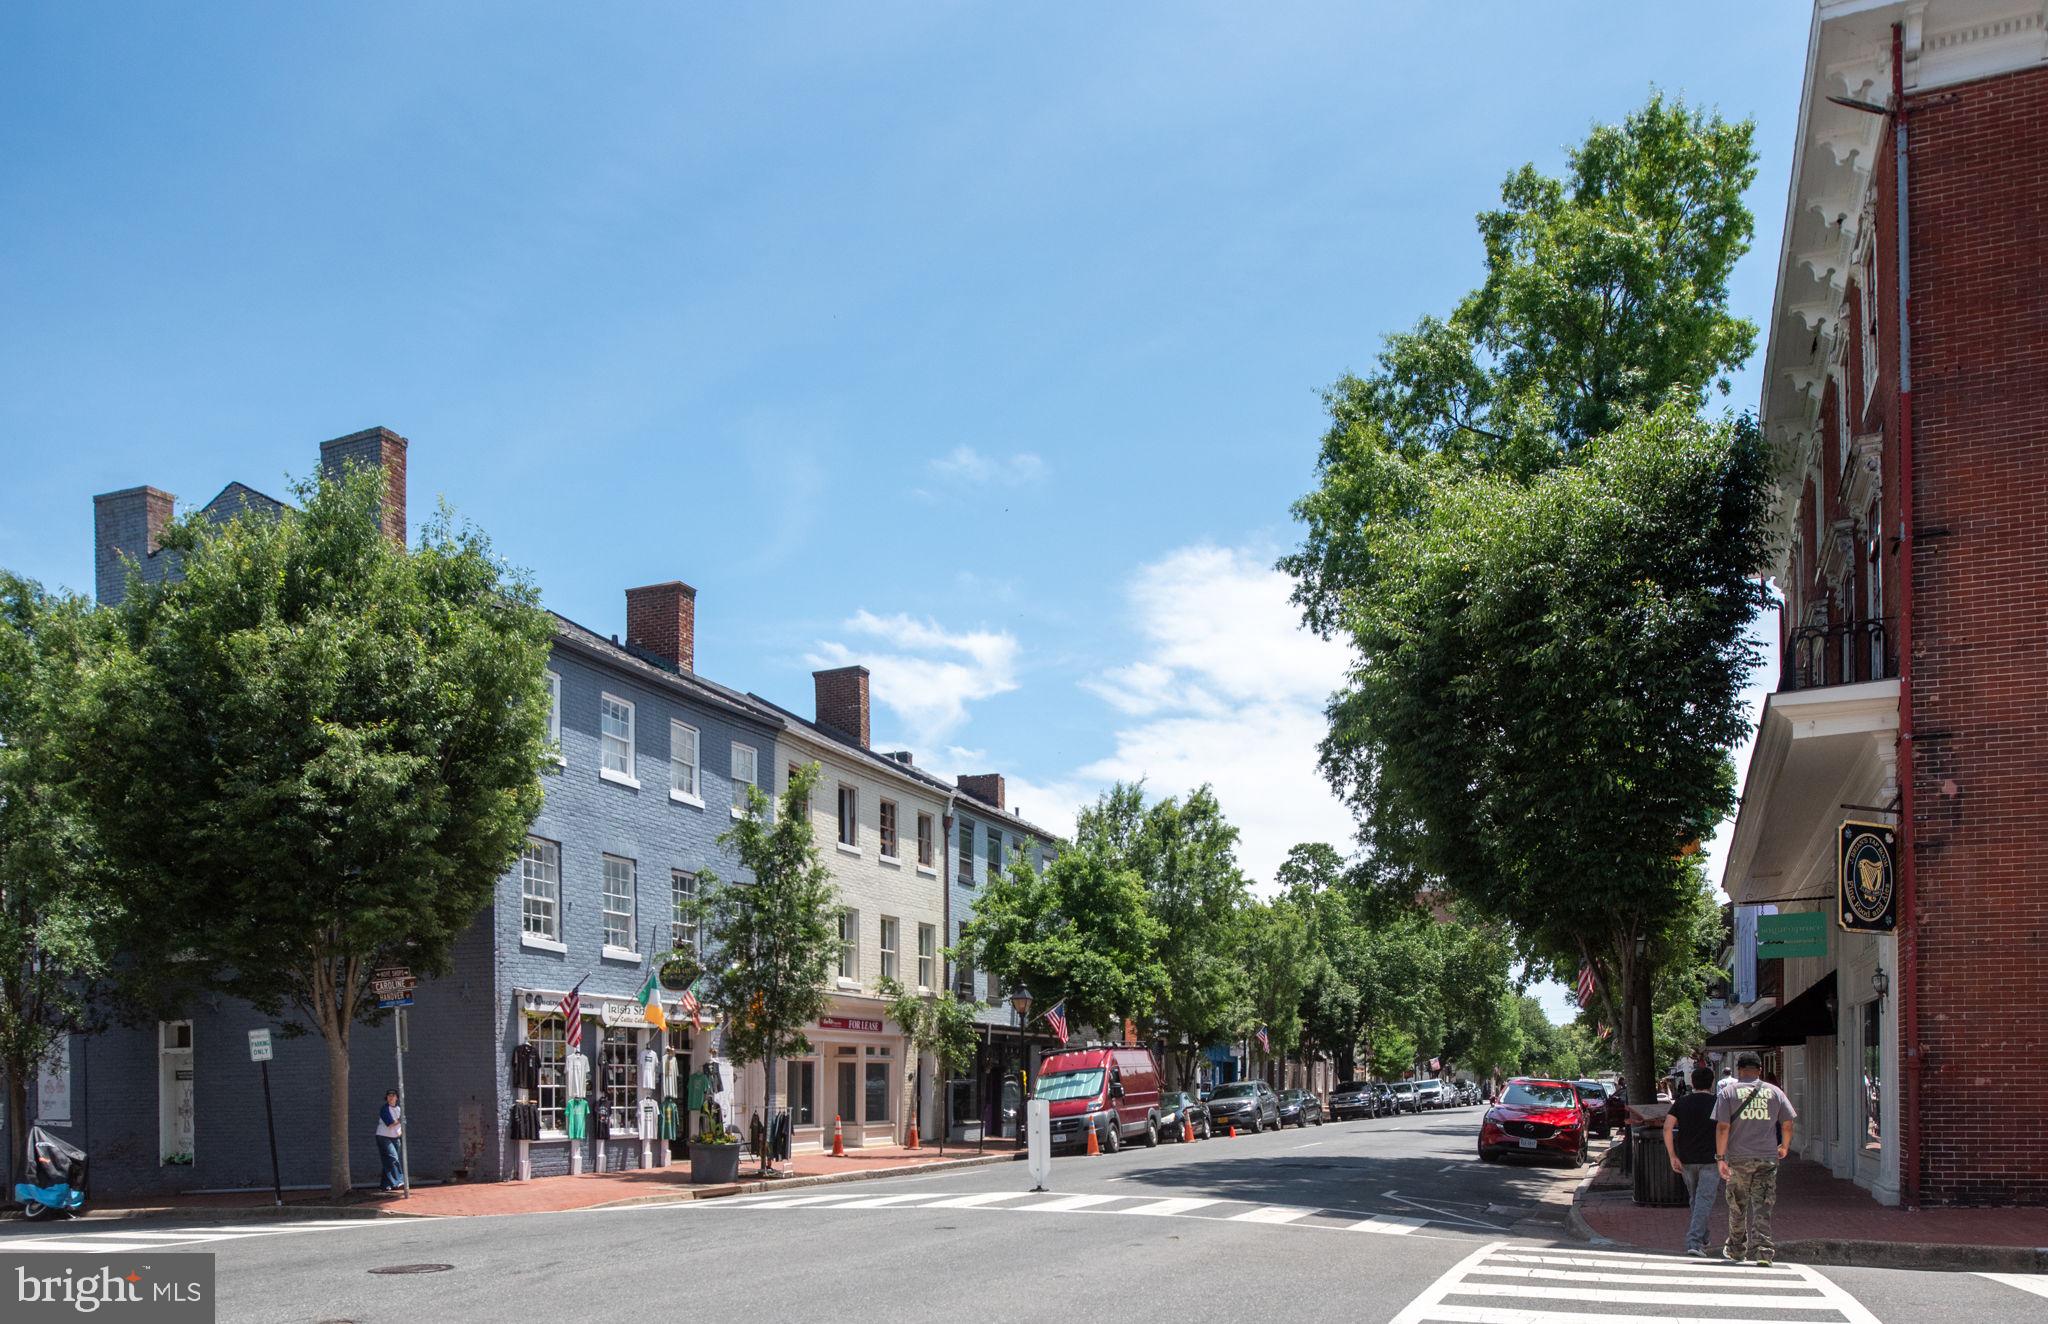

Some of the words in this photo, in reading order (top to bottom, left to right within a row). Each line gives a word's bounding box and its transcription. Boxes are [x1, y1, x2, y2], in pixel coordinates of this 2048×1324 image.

[1850, 838, 1869, 859] BRIAN'S
[1869, 838, 1880, 848] TAP
[1877, 847, 1889, 867] ROOM
[1848, 880, 1856, 900] Fine
[1854, 901, 1870, 918] Food
[1872, 902, 1884, 917] and
[1882, 883, 1890, 903] Ales
[375, 979, 406, 991] CAROLINE
[379, 991, 405, 1001] HANOVER
[848, 1019, 860, 1030] FOR
[861, 1020, 880, 1031] LEASE
[1740, 1108, 1771, 1120] COOL
